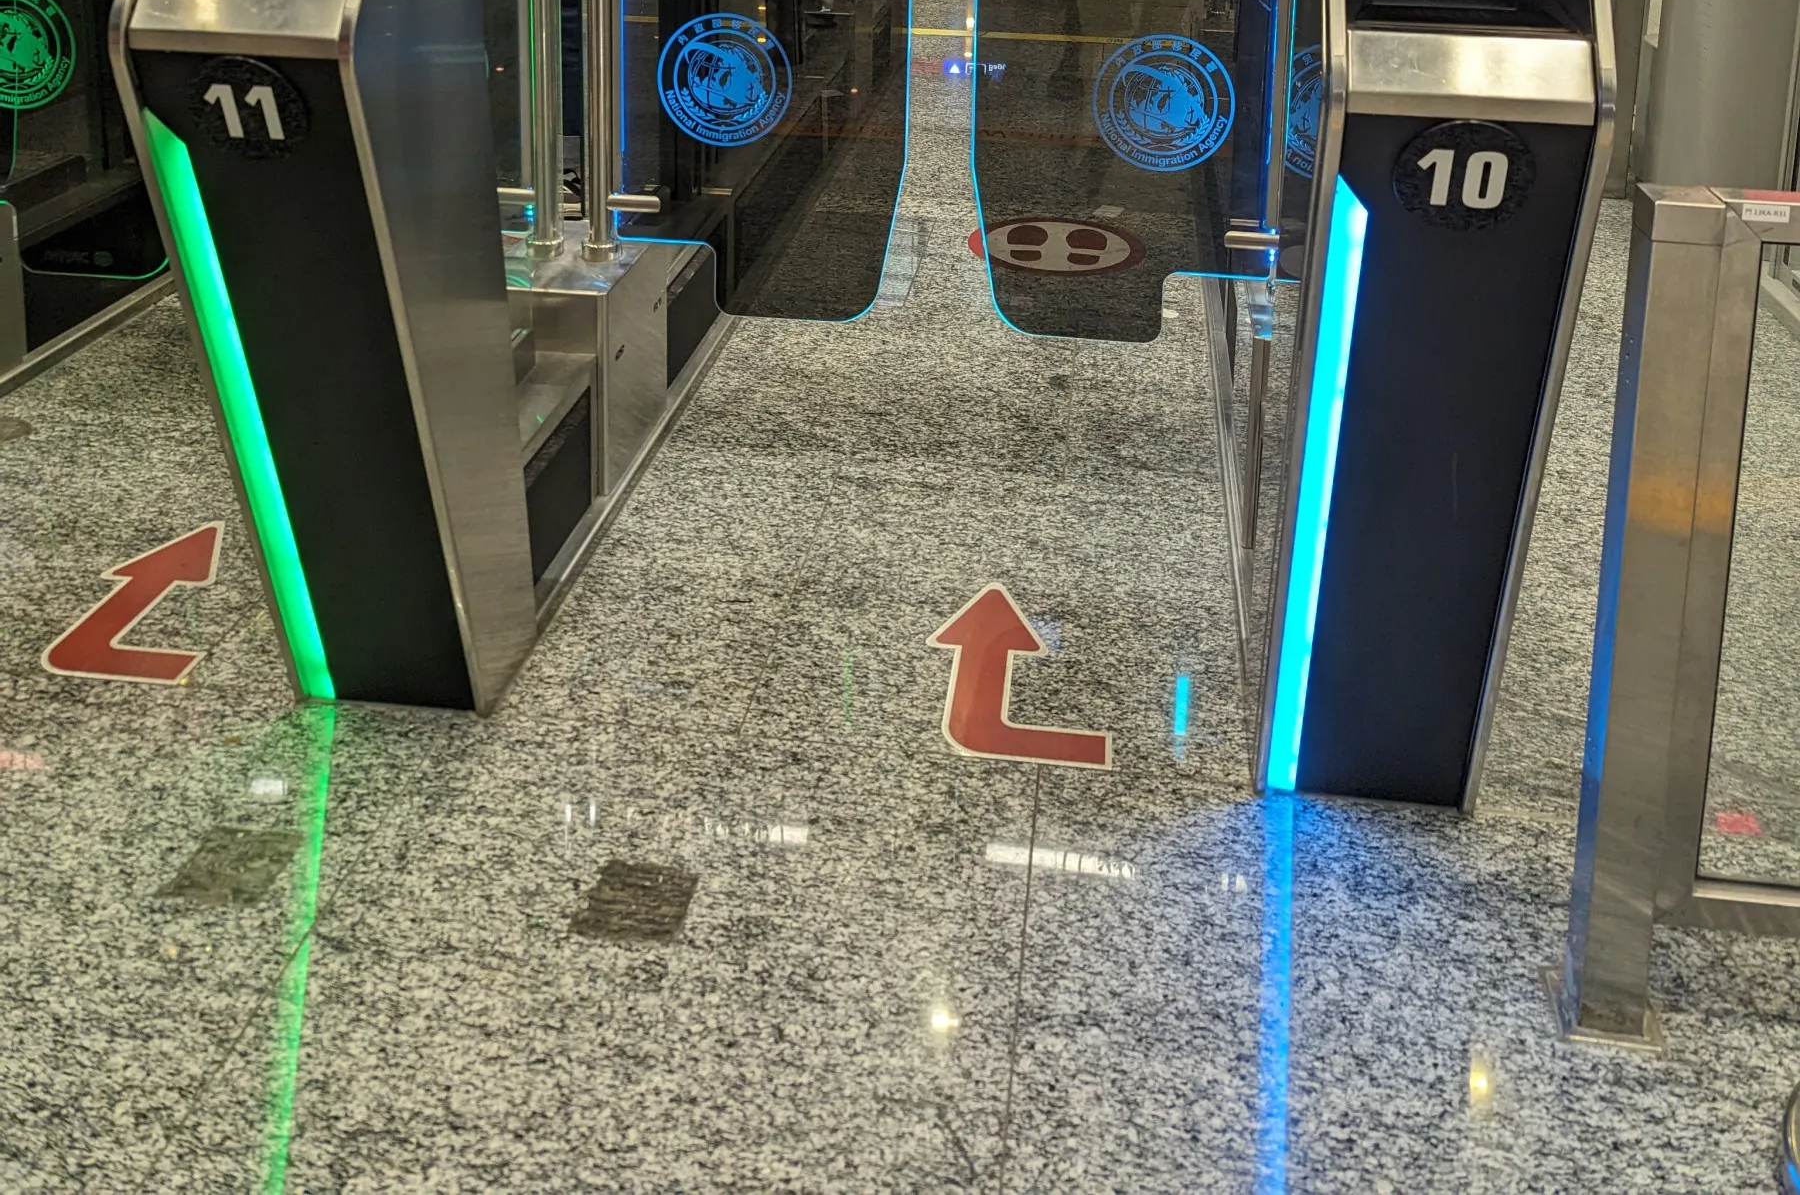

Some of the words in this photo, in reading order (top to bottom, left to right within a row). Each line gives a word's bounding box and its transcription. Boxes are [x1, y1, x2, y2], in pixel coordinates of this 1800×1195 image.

[47, 55, 70, 92] Agency
[203, 83, 286, 141] 11
[665, 89, 697, 129] National
[696, 124, 759, 142] Immigration
[759, 91, 786, 128] Agency
[1100, 112, 1129, 153] National
[1131, 148, 1198, 168] Immigration
[1198, 115, 1228, 153] Agency
[1416, 148, 1509, 210] 10
